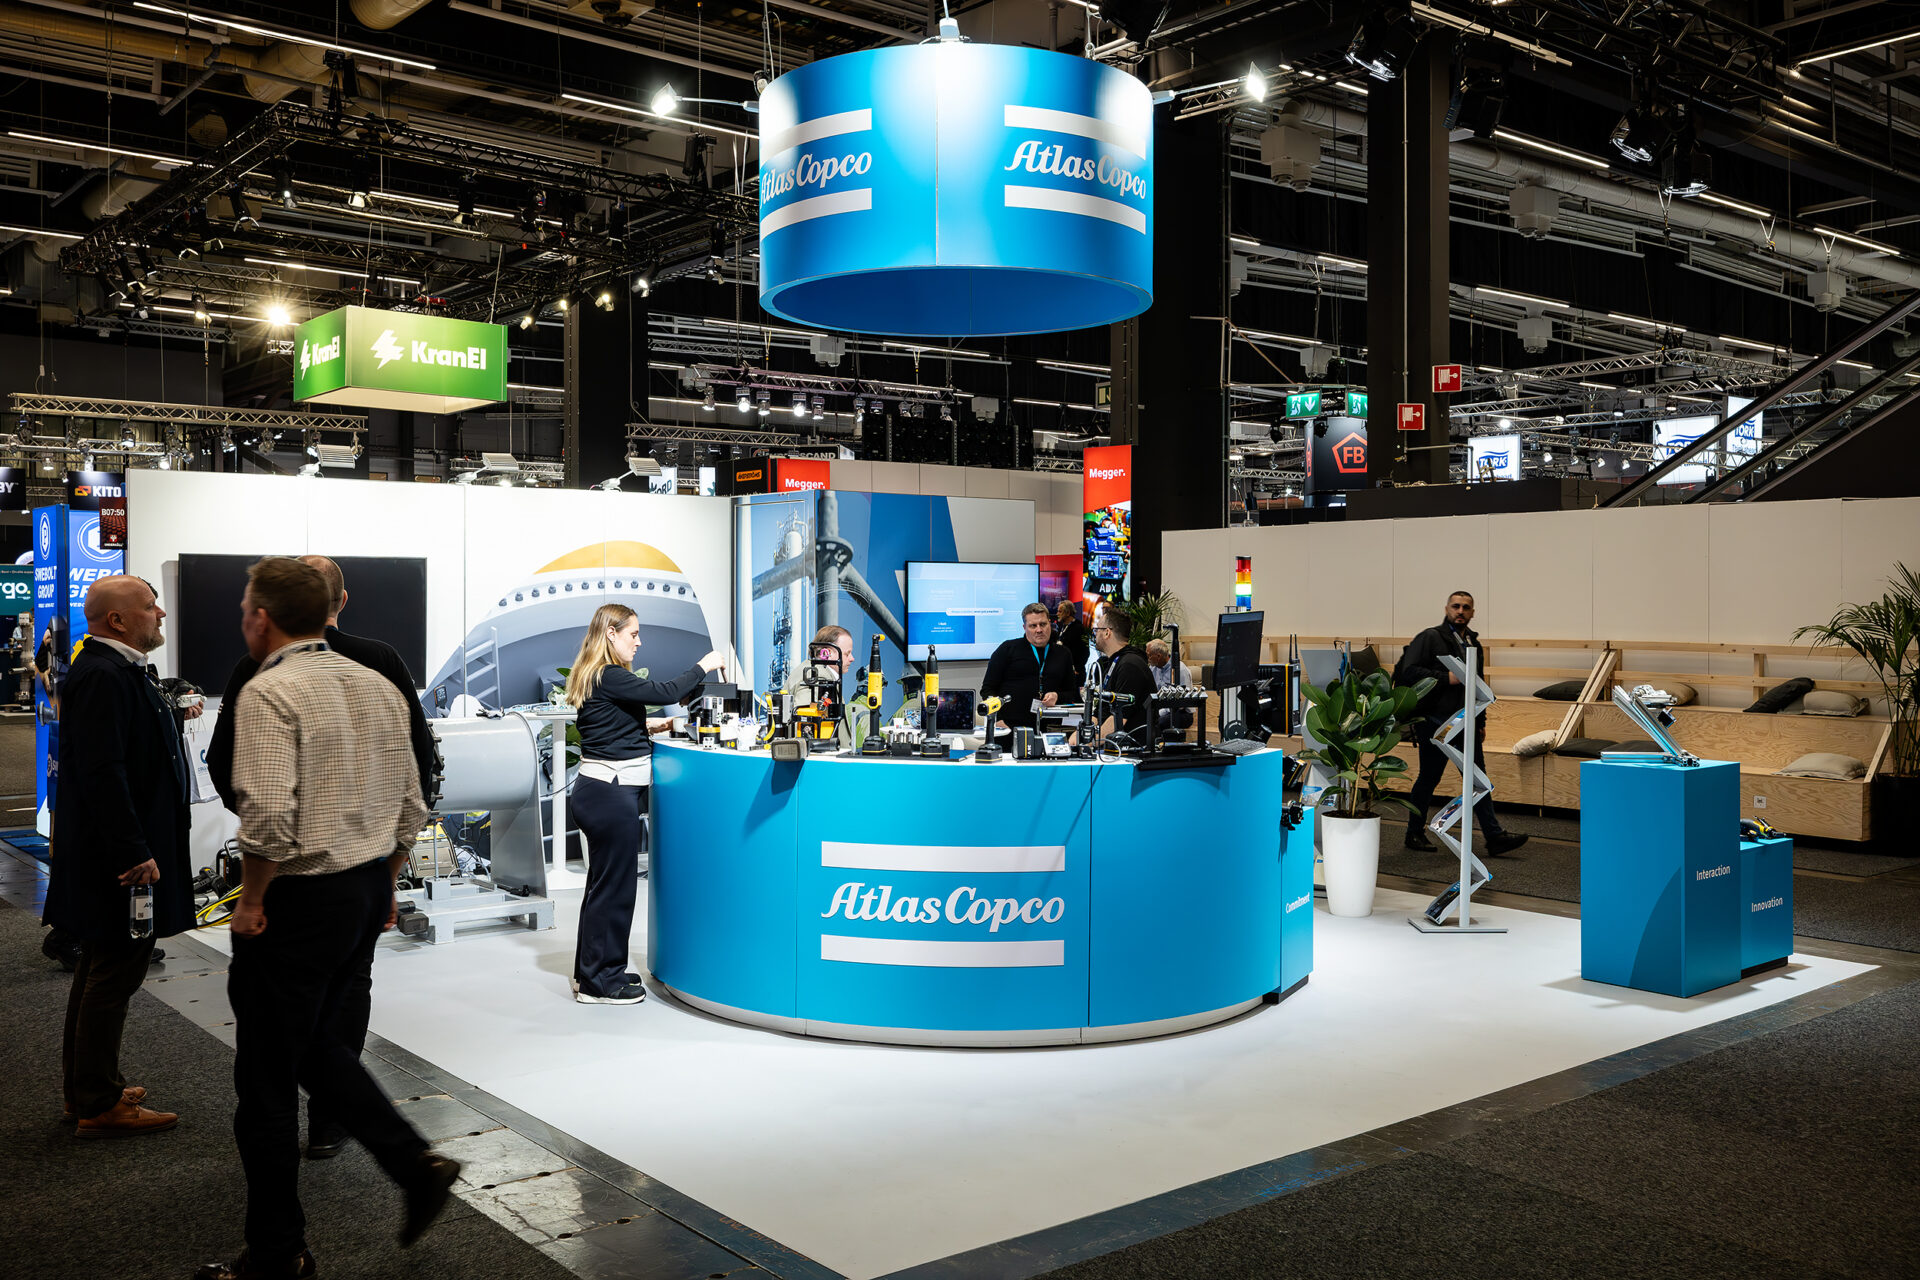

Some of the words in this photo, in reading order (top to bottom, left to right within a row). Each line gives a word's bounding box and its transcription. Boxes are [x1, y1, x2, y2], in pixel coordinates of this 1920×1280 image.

[1004, 140, 1096, 181] Atlas
[1097, 154, 1147, 200] Copco
[760, 168, 796, 209] Atlas
[796, 152, 873, 189] Copco
[1343, 446, 1365, 464] FB
[92, 485, 122, 497] KITO
[101, 508, 125, 517] B07:50
[35, 565, 57, 582] SWEBOLT
[0, 582, 31, 600] go.
[38, 583, 55, 599] GROUP
[1099, 583, 1117, 593] ADX
[1696, 864, 1731, 881] Interaction
[821, 882, 941, 924] Atlas
[945, 886, 1066, 933] Copco
[1751, 896, 1784, 913] Innovation
